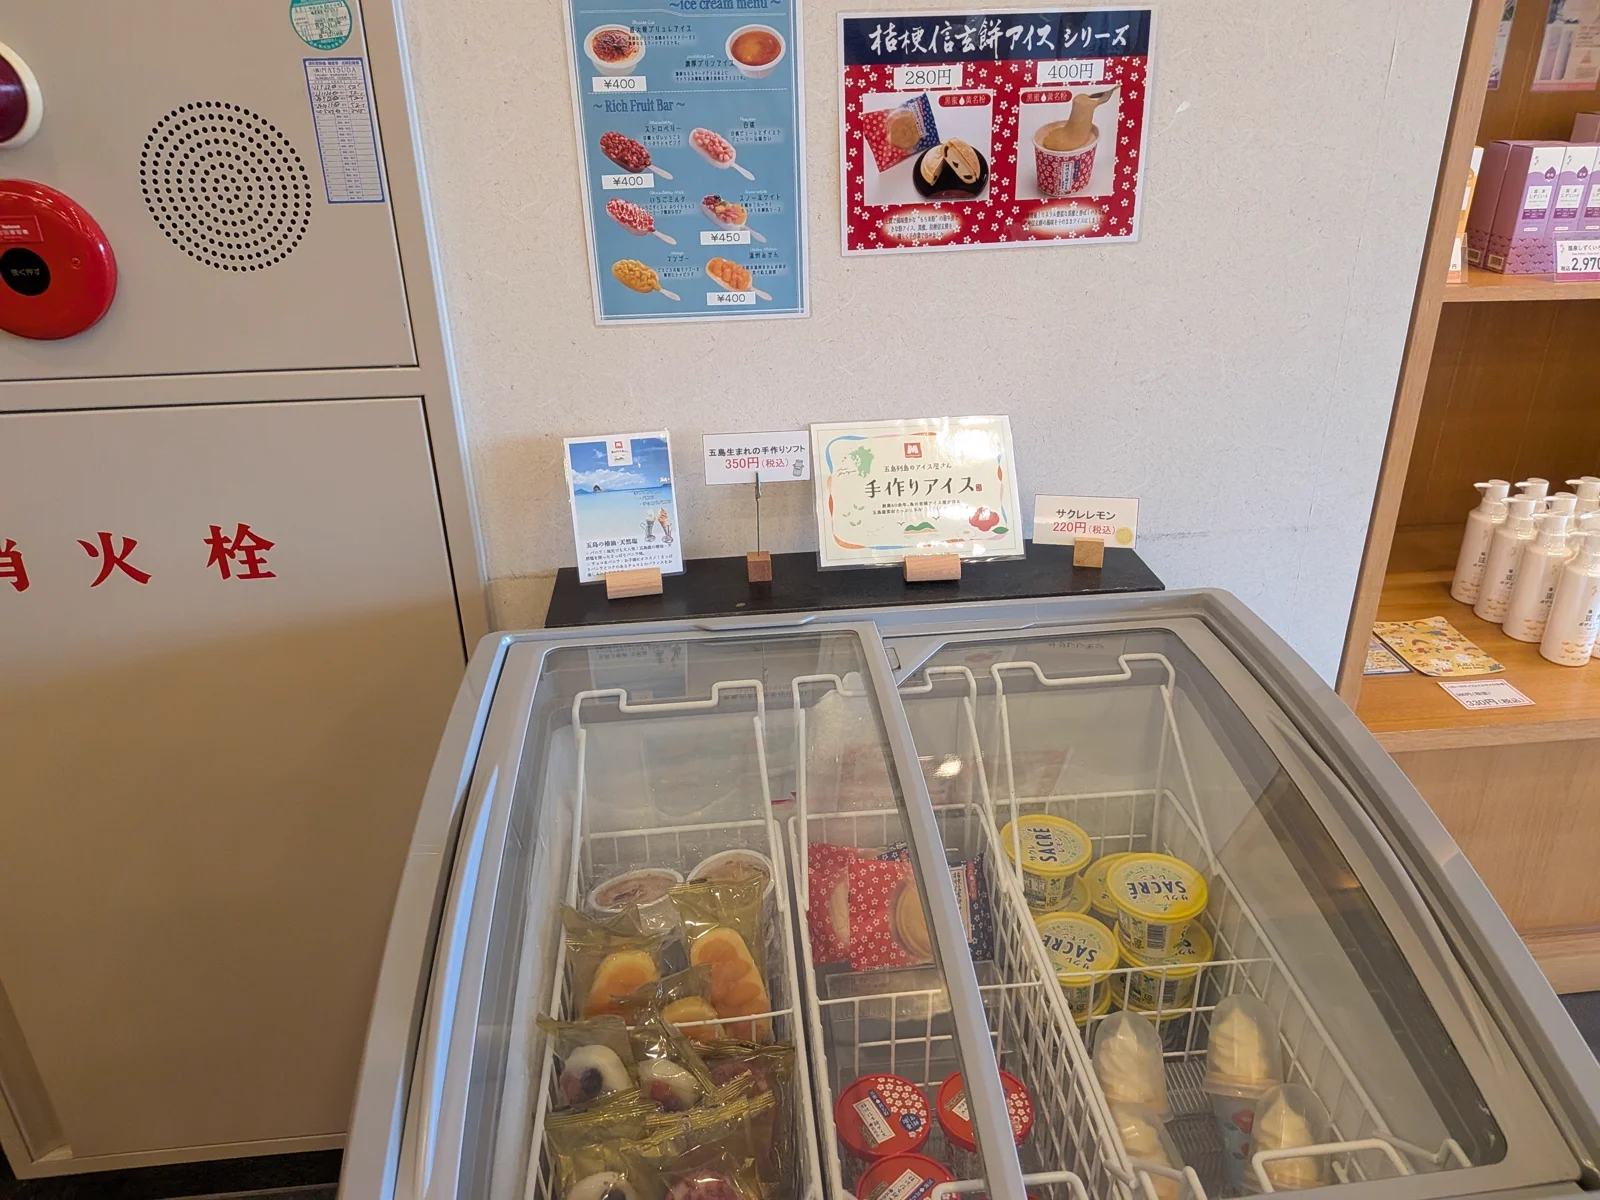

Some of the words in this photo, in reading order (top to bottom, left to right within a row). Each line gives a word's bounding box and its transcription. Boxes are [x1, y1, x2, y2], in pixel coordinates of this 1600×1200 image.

[868, 18, 1056, 59] 桔梗信玄餅アイス
[1064, 23, 1131, 48] シリーズ
[905, 68, 952, 86] 280円
[1047, 63, 1093, 79] 400円
[604, 78, 636, 90] ¥400
[605, 100, 628, 112] Rich
[631, 99, 655, 112] Fruit
[657, 98, 675, 111] Bar
[645, 125, 682, 133] ストロベリー
[612, 176, 644, 187] ¥400
[649, 196, 686, 204] いちごミルク
[740, 194, 781, 202] スノーホワイト
[710, 232, 740, 243] ¥450
[716, 293, 746, 304] ¥400
[709, 444, 806, 457] 五島生まれの手作りソフト
[884, 462, 952, 473] 五島列島のアイス屋さん
[865, 477, 975, 499] 手作りアイス
[1056, 508, 1116, 521] サクレレモン
[586, 538, 638, 548] 五島の椿油・天然塩
[1127, 881, 1187, 900] SACRÉ
